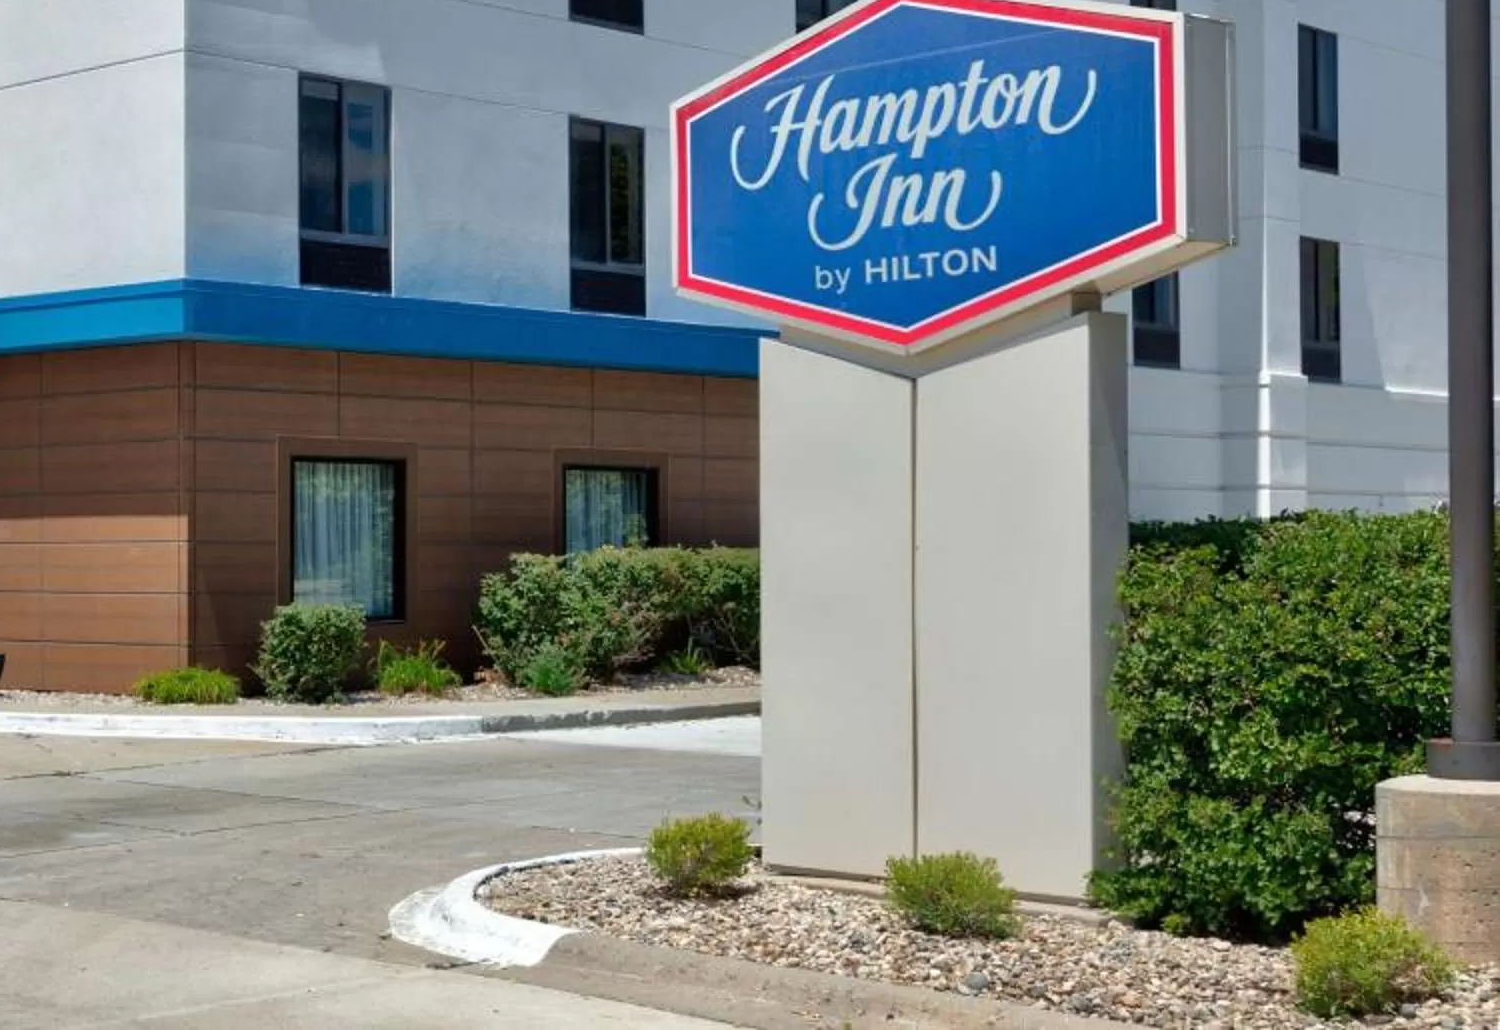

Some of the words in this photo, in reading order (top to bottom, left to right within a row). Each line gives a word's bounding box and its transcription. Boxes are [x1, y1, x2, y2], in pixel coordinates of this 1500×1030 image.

[729, 58, 1097, 191] Hampton
[807, 152, 1002, 252] Inn
[815, 264, 852, 296] by
[864, 244, 999, 285] HILTON
